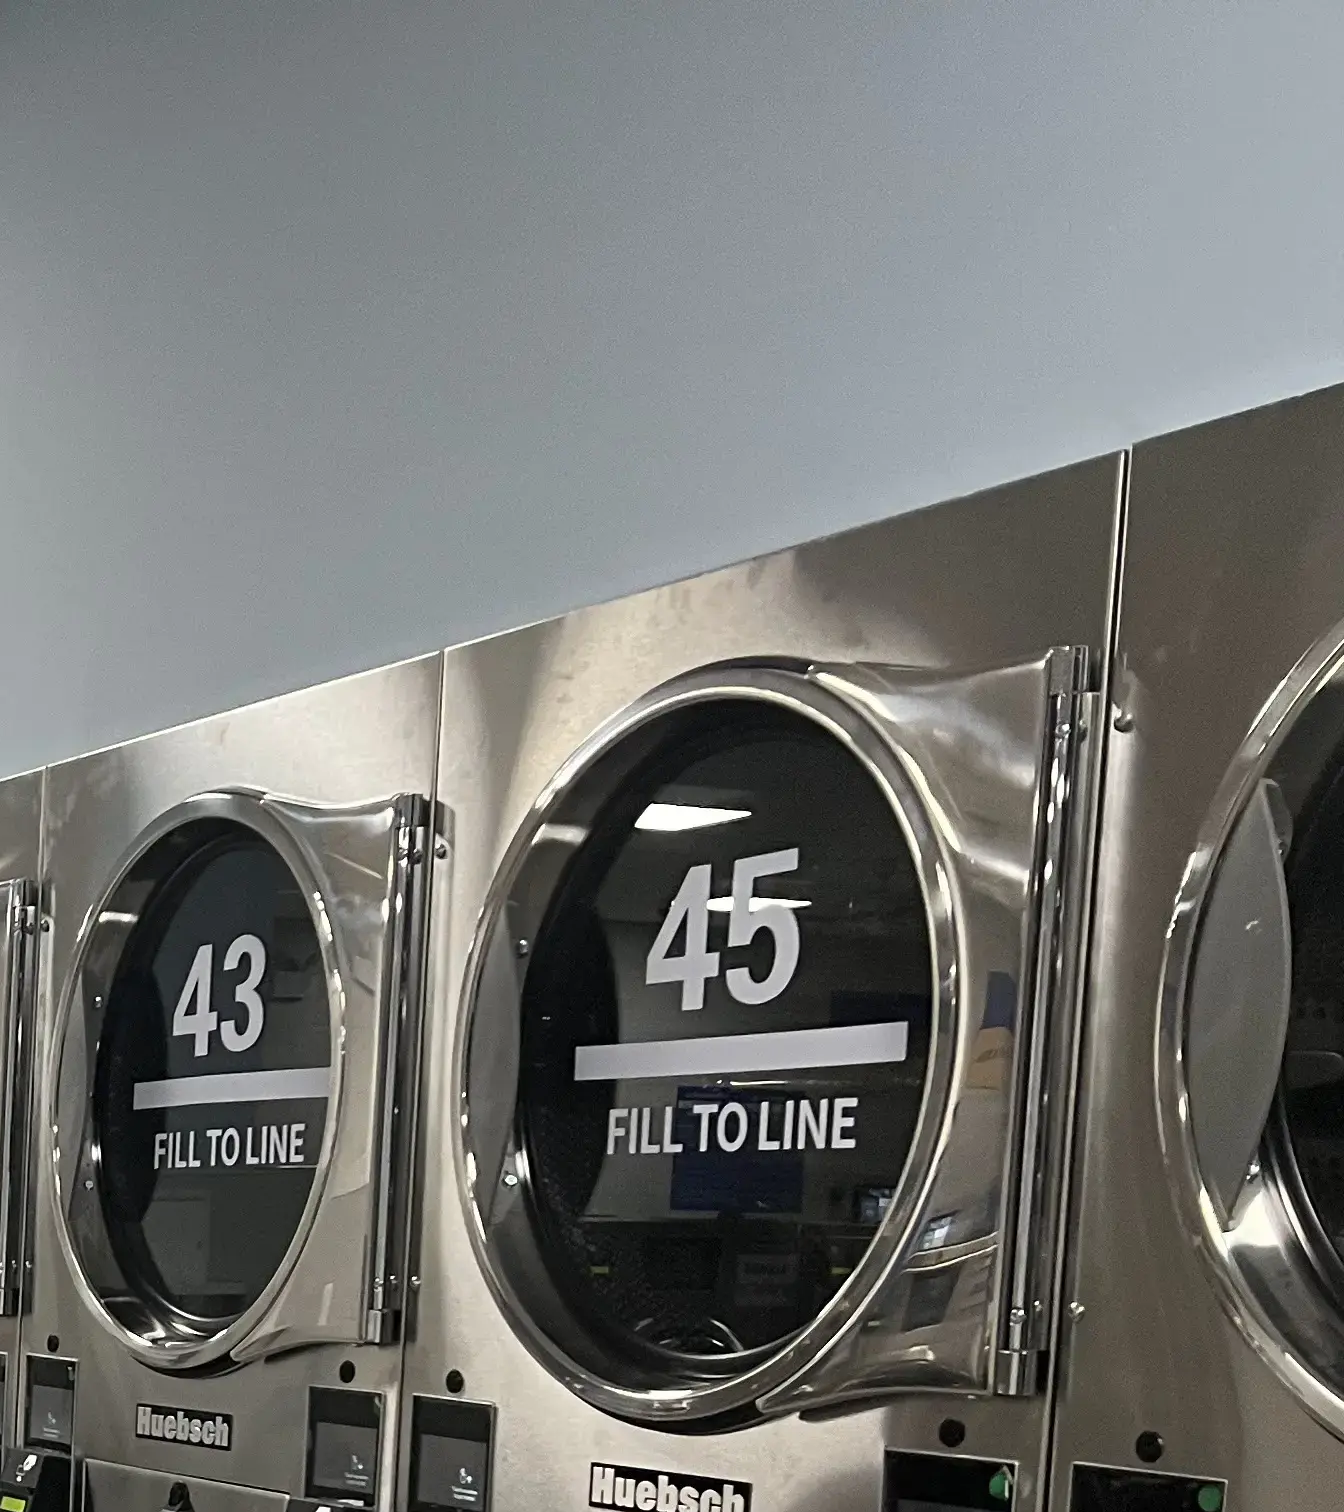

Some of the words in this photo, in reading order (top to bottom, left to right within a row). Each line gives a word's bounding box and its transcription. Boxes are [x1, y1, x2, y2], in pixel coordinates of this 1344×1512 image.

[645, 847, 800, 1011] 45
[172, 933, 267, 1058] 43
[153, 1129, 201, 1171] FILL
[206, 1128, 240, 1168] TO
[245, 1122, 306, 1167] LINE
[606, 1105, 683, 1156] FILL
[693, 1101, 748, 1152] TO
[757, 1097, 859, 1152] LINE
[136, 1405, 230, 1449] Huebsch
